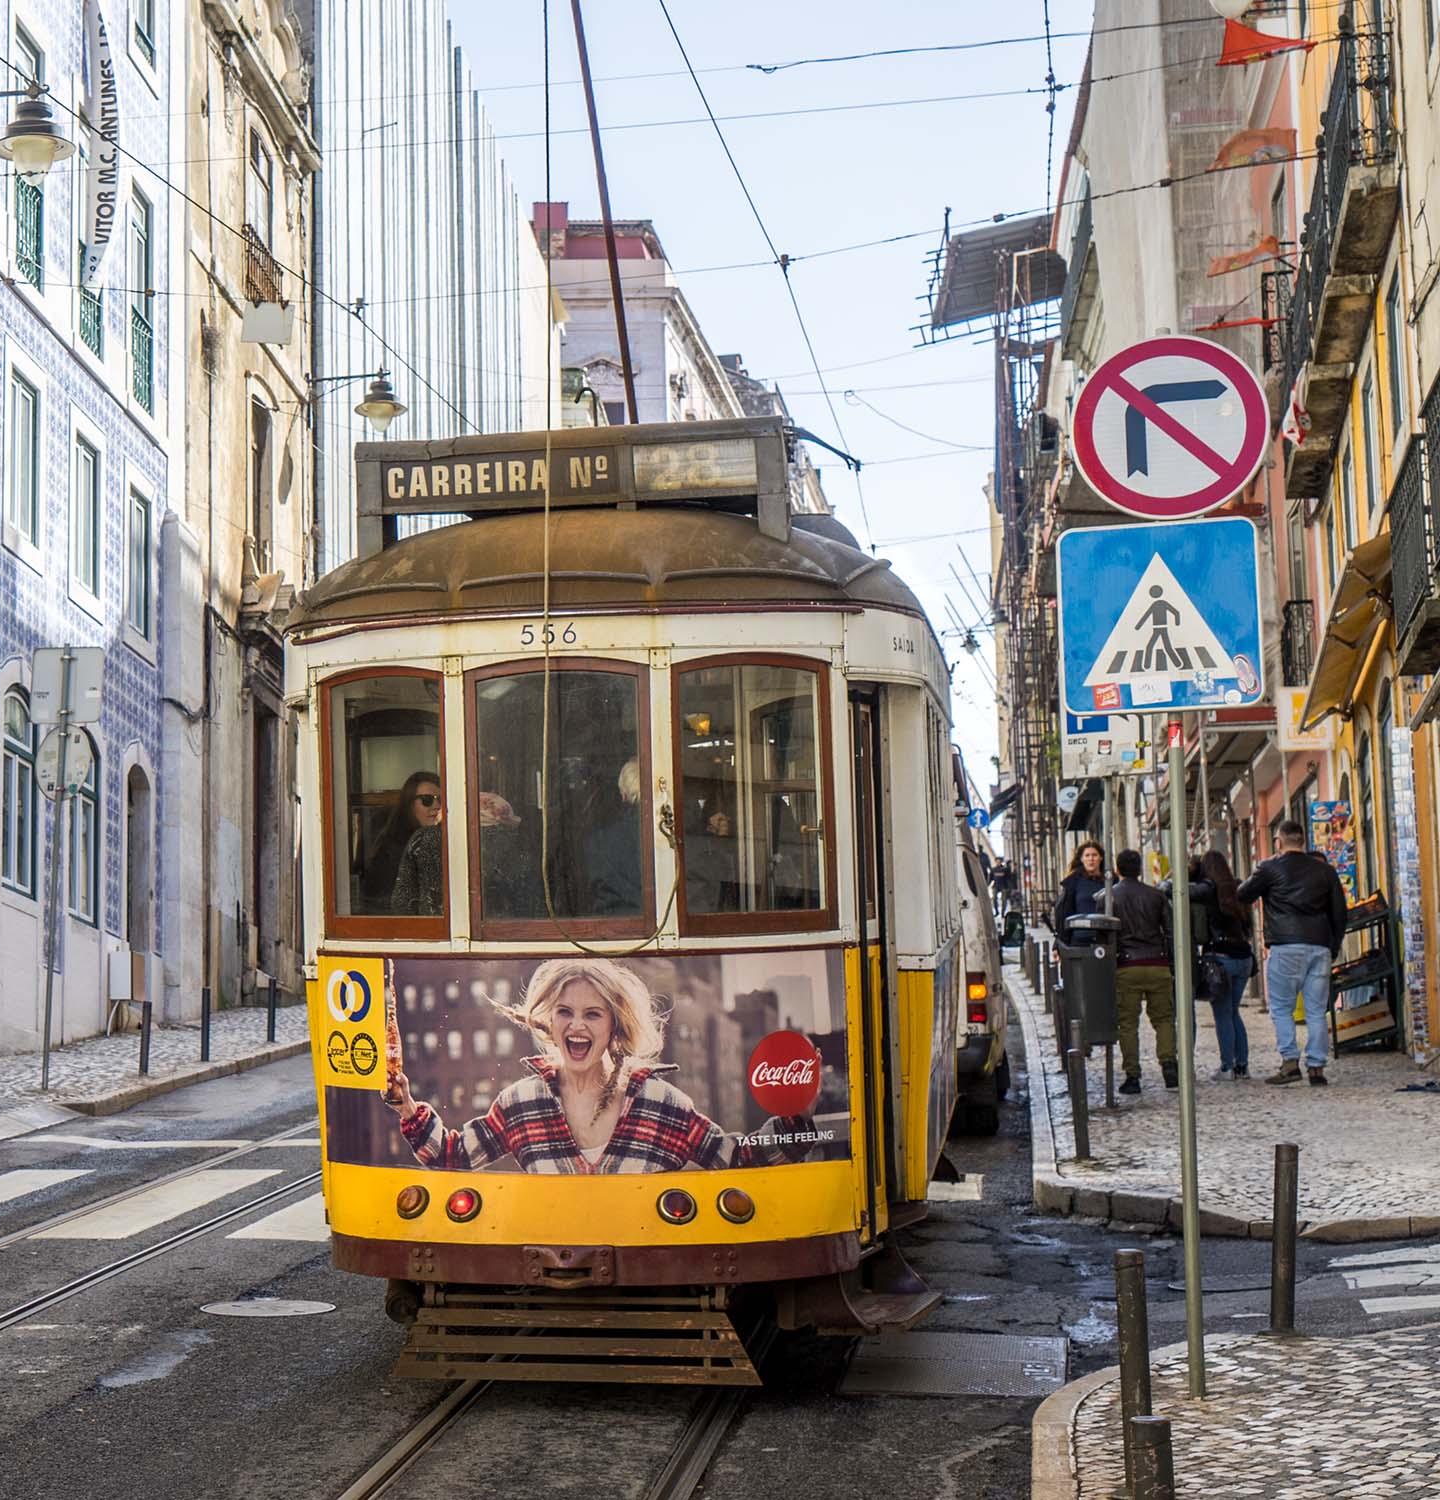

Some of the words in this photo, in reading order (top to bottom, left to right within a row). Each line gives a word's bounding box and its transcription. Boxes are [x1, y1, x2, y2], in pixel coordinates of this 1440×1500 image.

[100, 58, 118, 142] ANTUNES
[94, 191, 115, 245] VITOR
[387, 458, 548, 499] CARREIRA
[649, 442, 722, 491] 28
[520, 621, 577, 645] 556
[751, 1058, 817, 1087] Coca-Cola
[736, 1135, 771, 1147] TASTE
[772, 1133, 793, 1145] THE
[794, 1130, 834, 1143] FEELING
